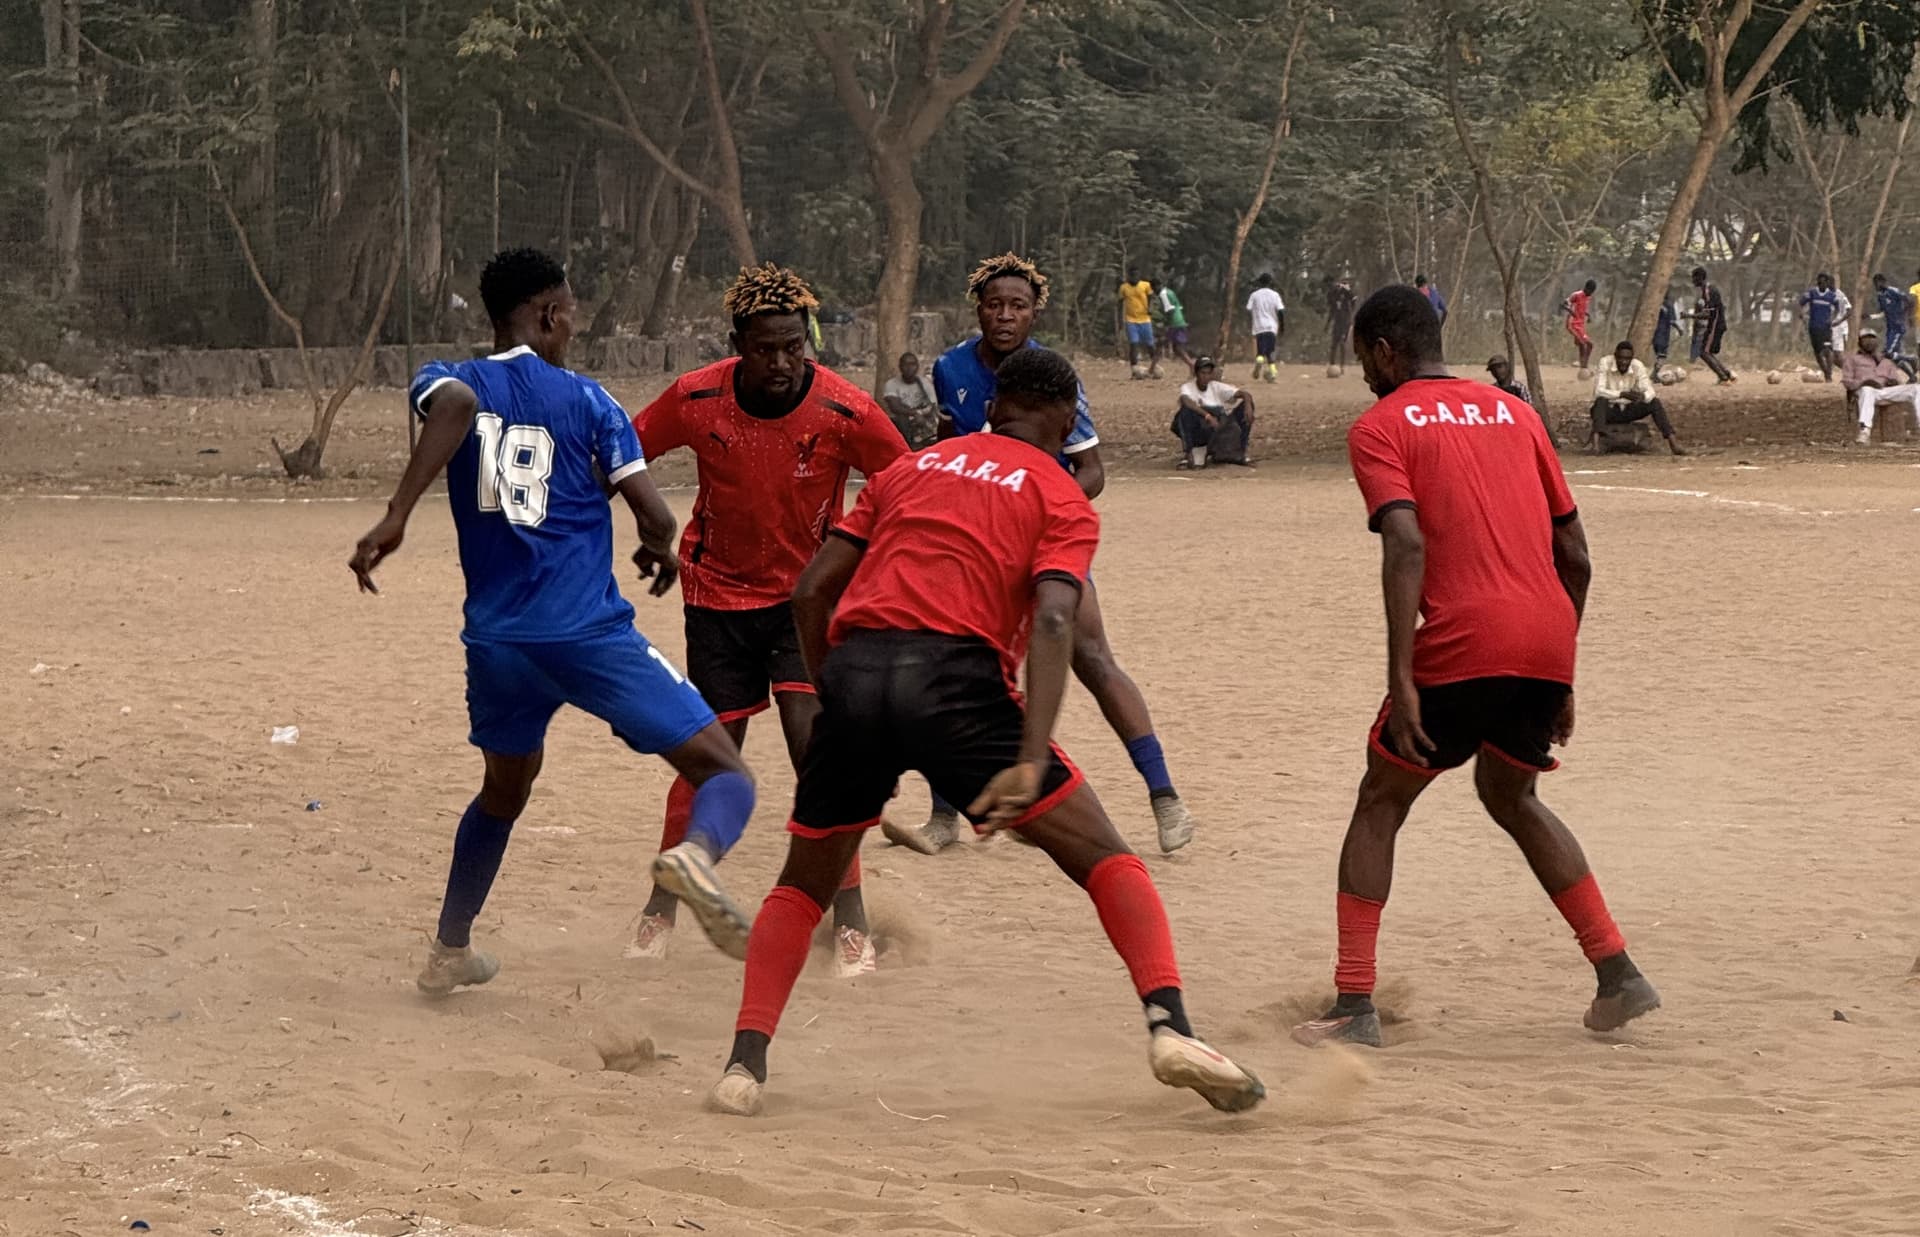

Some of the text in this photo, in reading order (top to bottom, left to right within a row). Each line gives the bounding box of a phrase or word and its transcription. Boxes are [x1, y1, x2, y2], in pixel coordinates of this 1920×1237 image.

[1404, 400, 1516, 427] C.A.R.A
[475, 412, 555, 528] 18
[916, 452, 1028, 492] C.A.R.A
